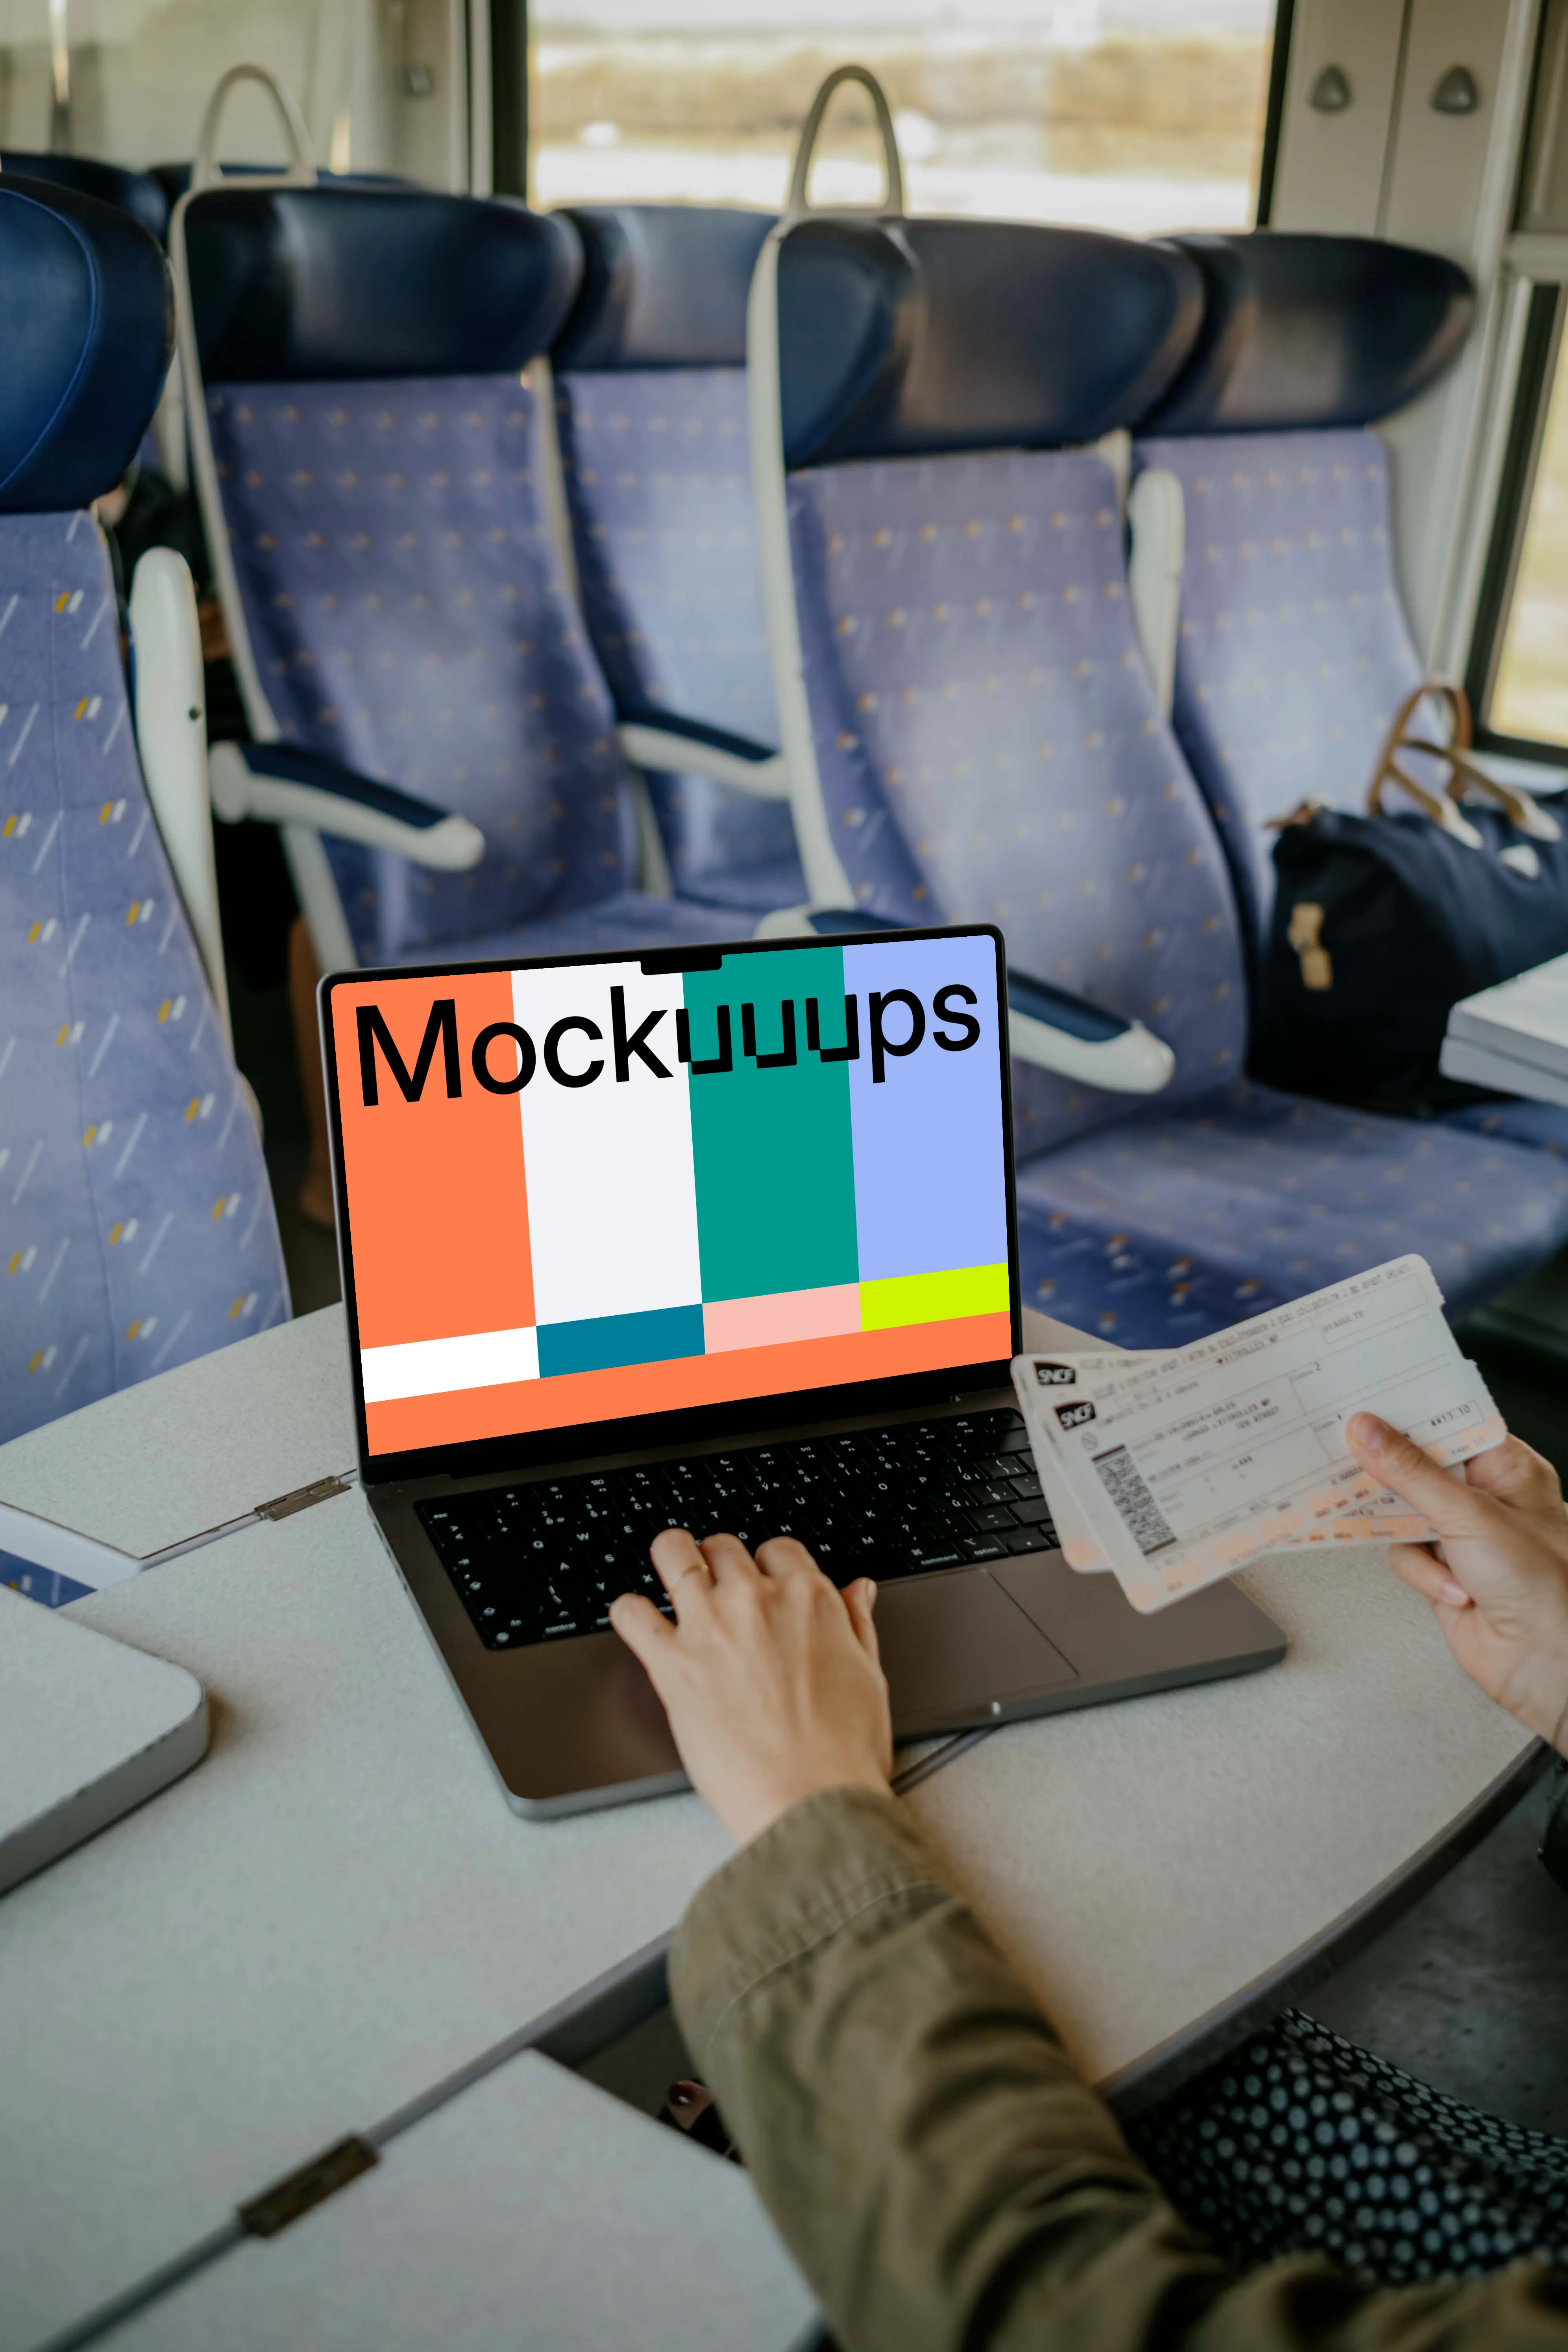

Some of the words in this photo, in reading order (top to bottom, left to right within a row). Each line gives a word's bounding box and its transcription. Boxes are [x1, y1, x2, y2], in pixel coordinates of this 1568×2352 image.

[356, 984, 980, 1107] Mockuuups
[1315, 1362, 1321, 1371] 2
[1037, 1368, 1074, 1383] SNCF
[1060, 1403, 1093, 1427] SNCF
[623, 1525, 633, 1533] E
[577, 1532, 589, 1541] W
[738, 1533, 748, 1542] G
[974, 1547, 999, 1555] option
[921, 1553, 958, 1565] command
[560, 1562, 570, 1570] A
[643, 1574, 653, 1583] X
[545, 1622, 577, 1633] control
